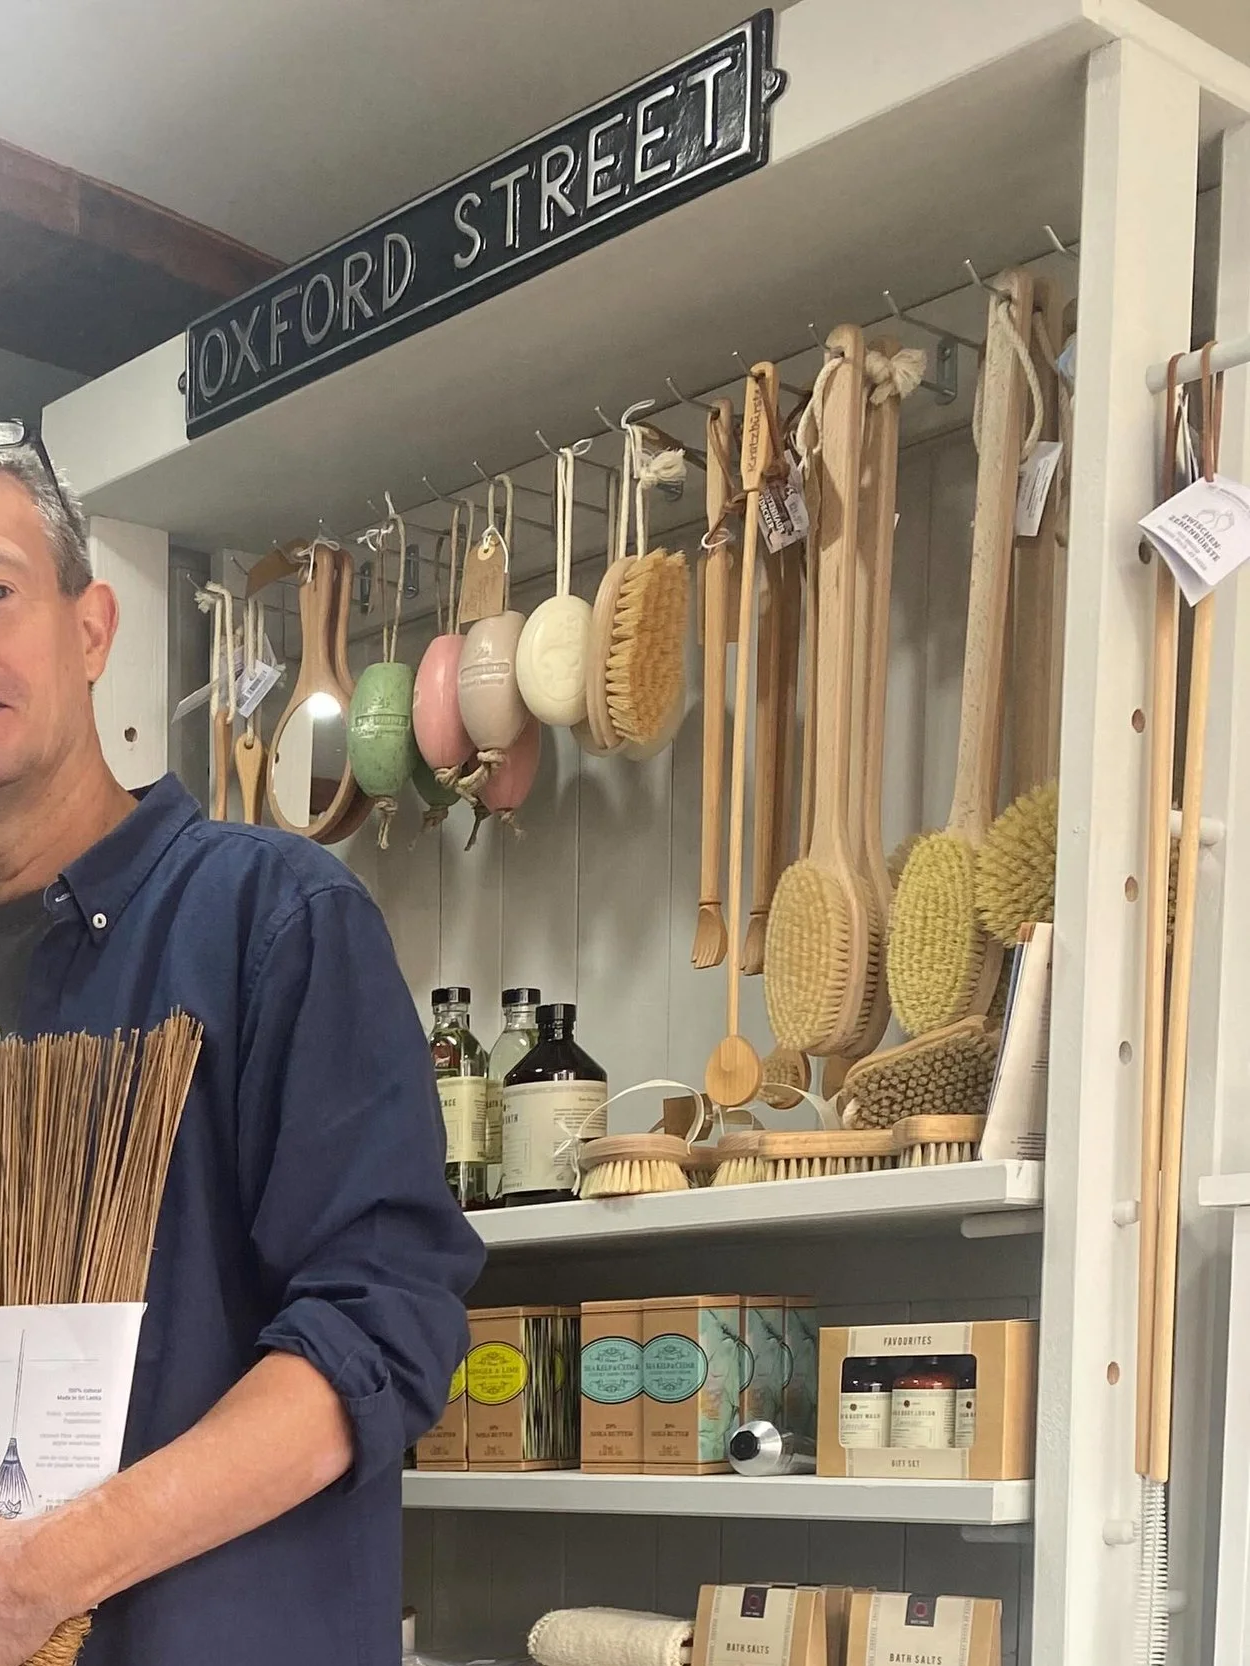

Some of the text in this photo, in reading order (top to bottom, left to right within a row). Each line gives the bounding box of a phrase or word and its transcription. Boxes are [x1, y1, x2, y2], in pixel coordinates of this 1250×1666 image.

[197, 56, 734, 402] OXFORD STREET
[883, 1335, 933, 1347] FAVOURITES
[908, 1459, 921, 1468] SET
[726, 1642, 770, 1655] BATH SALTS
[889, 1652, 943, 1666] BATH SALTS
